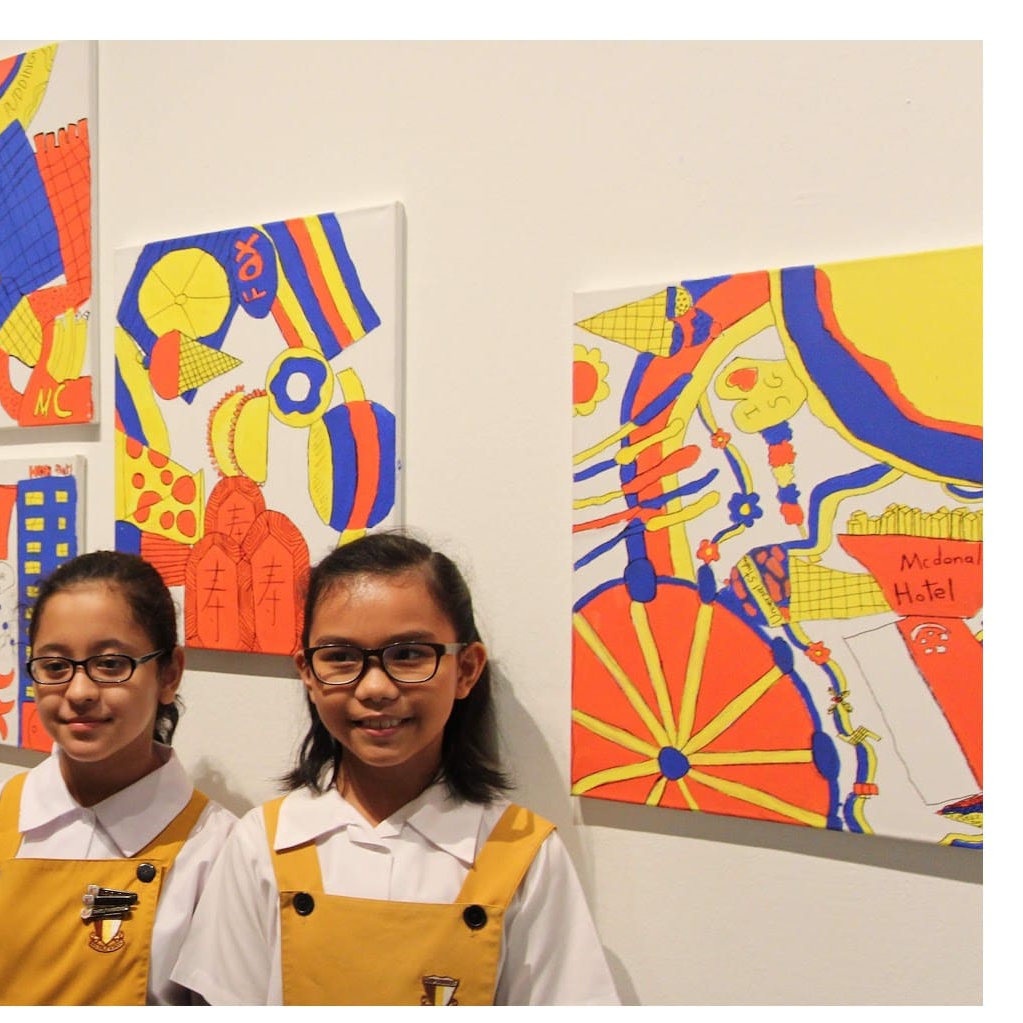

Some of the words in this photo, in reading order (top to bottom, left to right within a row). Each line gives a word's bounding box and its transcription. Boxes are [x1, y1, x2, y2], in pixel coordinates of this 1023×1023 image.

[235, 232, 267, 303] FOX
[34, 384, 73, 418] MC
[894, 578, 955, 606] Hotel
